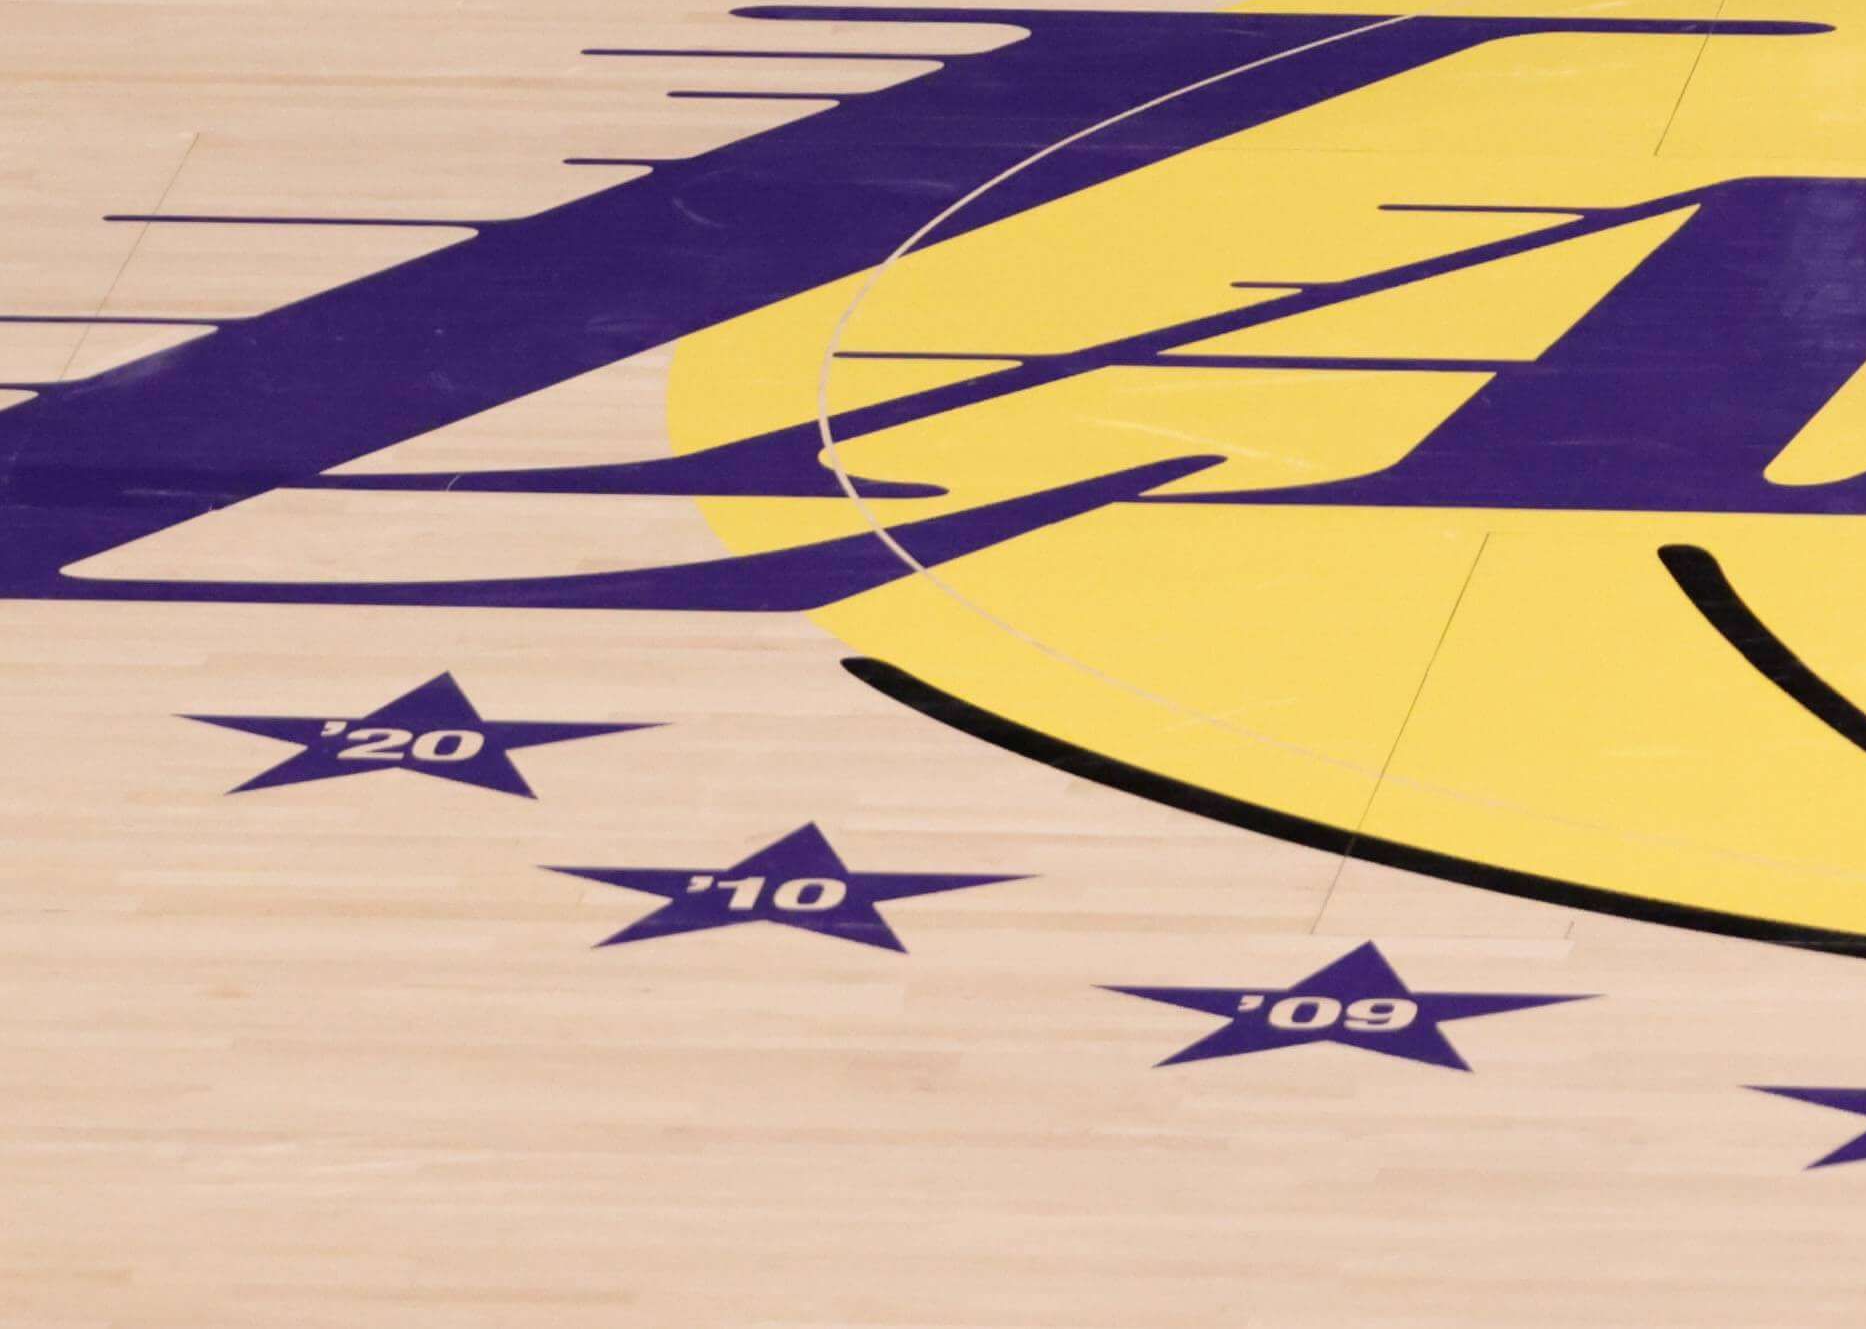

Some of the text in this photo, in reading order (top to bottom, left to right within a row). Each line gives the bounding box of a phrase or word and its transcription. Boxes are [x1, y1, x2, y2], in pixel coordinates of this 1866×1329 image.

[318, 721, 486, 764] '20
[685, 872, 848, 913] '10
[1234, 994, 1419, 1033] '09
